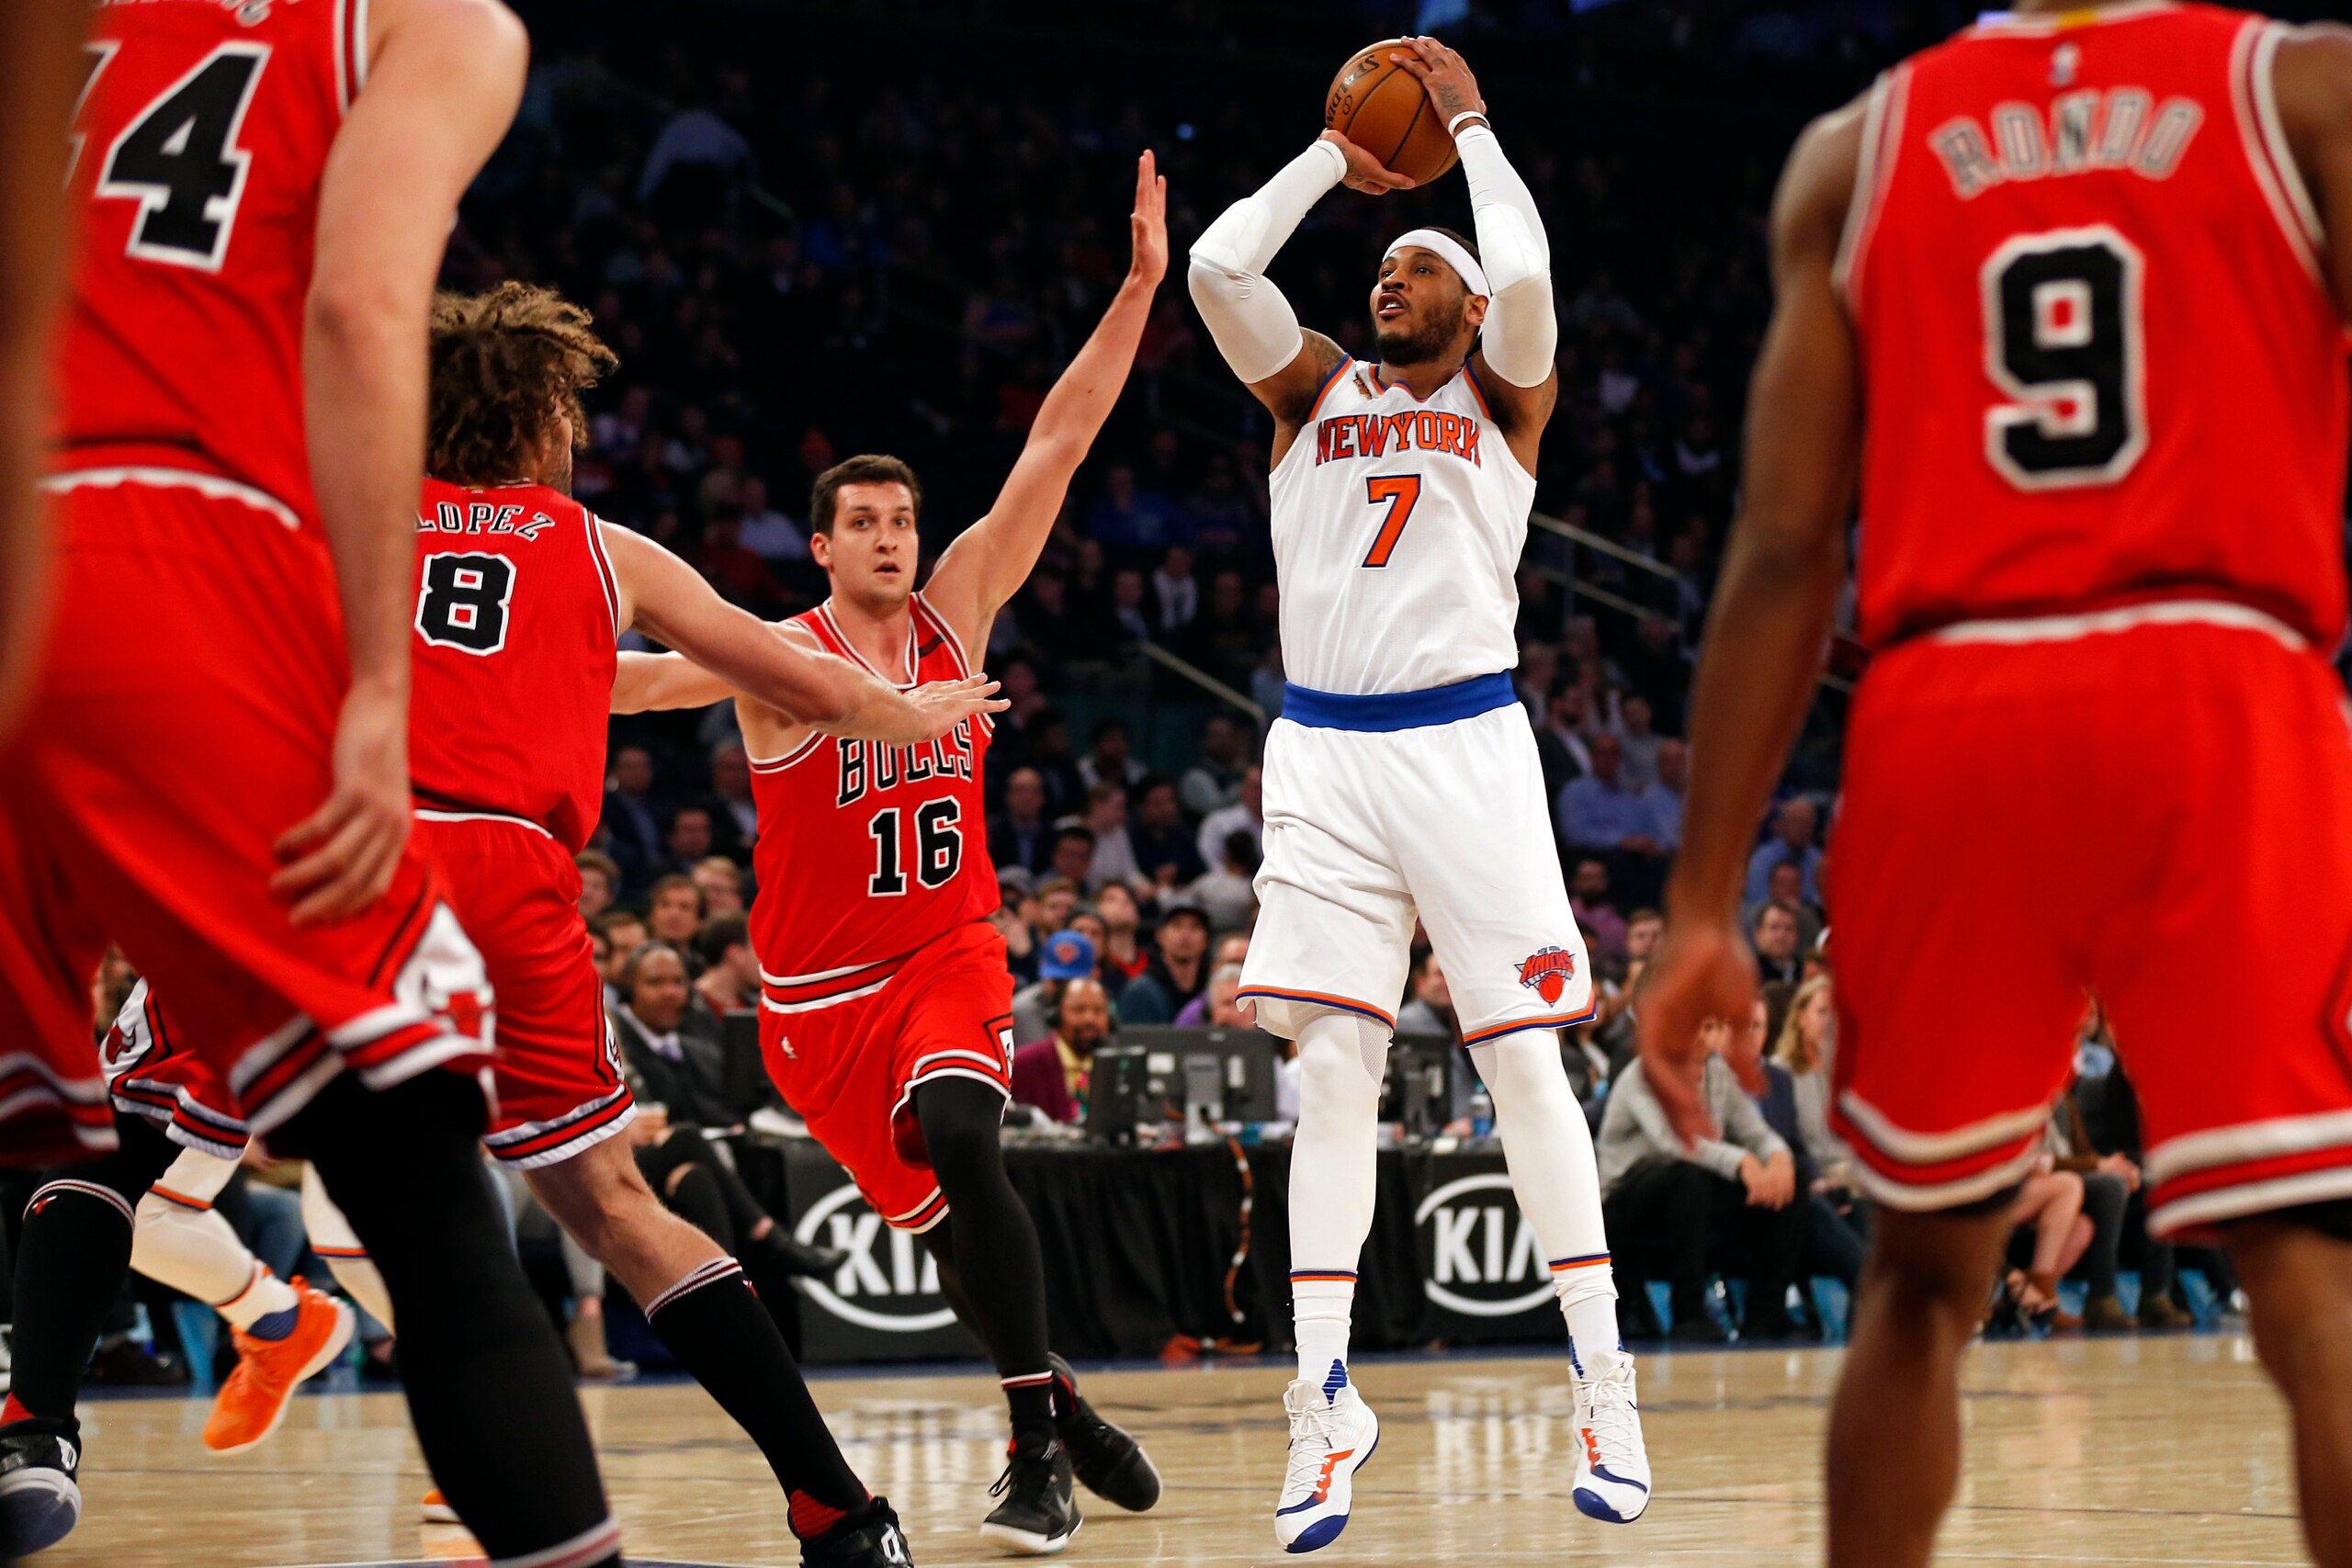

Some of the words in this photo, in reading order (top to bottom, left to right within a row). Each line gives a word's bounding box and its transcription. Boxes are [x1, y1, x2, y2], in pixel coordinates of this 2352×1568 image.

[1926, 85, 2205, 201] RONDO
[1979, 223, 2150, 492] 9
[416, 502, 556, 543] LOPEZ
[1361, 473, 1422, 569] 7
[413, 551, 517, 657] 8
[835, 716, 973, 809] BULLS
[867, 795, 963, 897] 16
[1433, 1207, 1554, 1283] KIA
